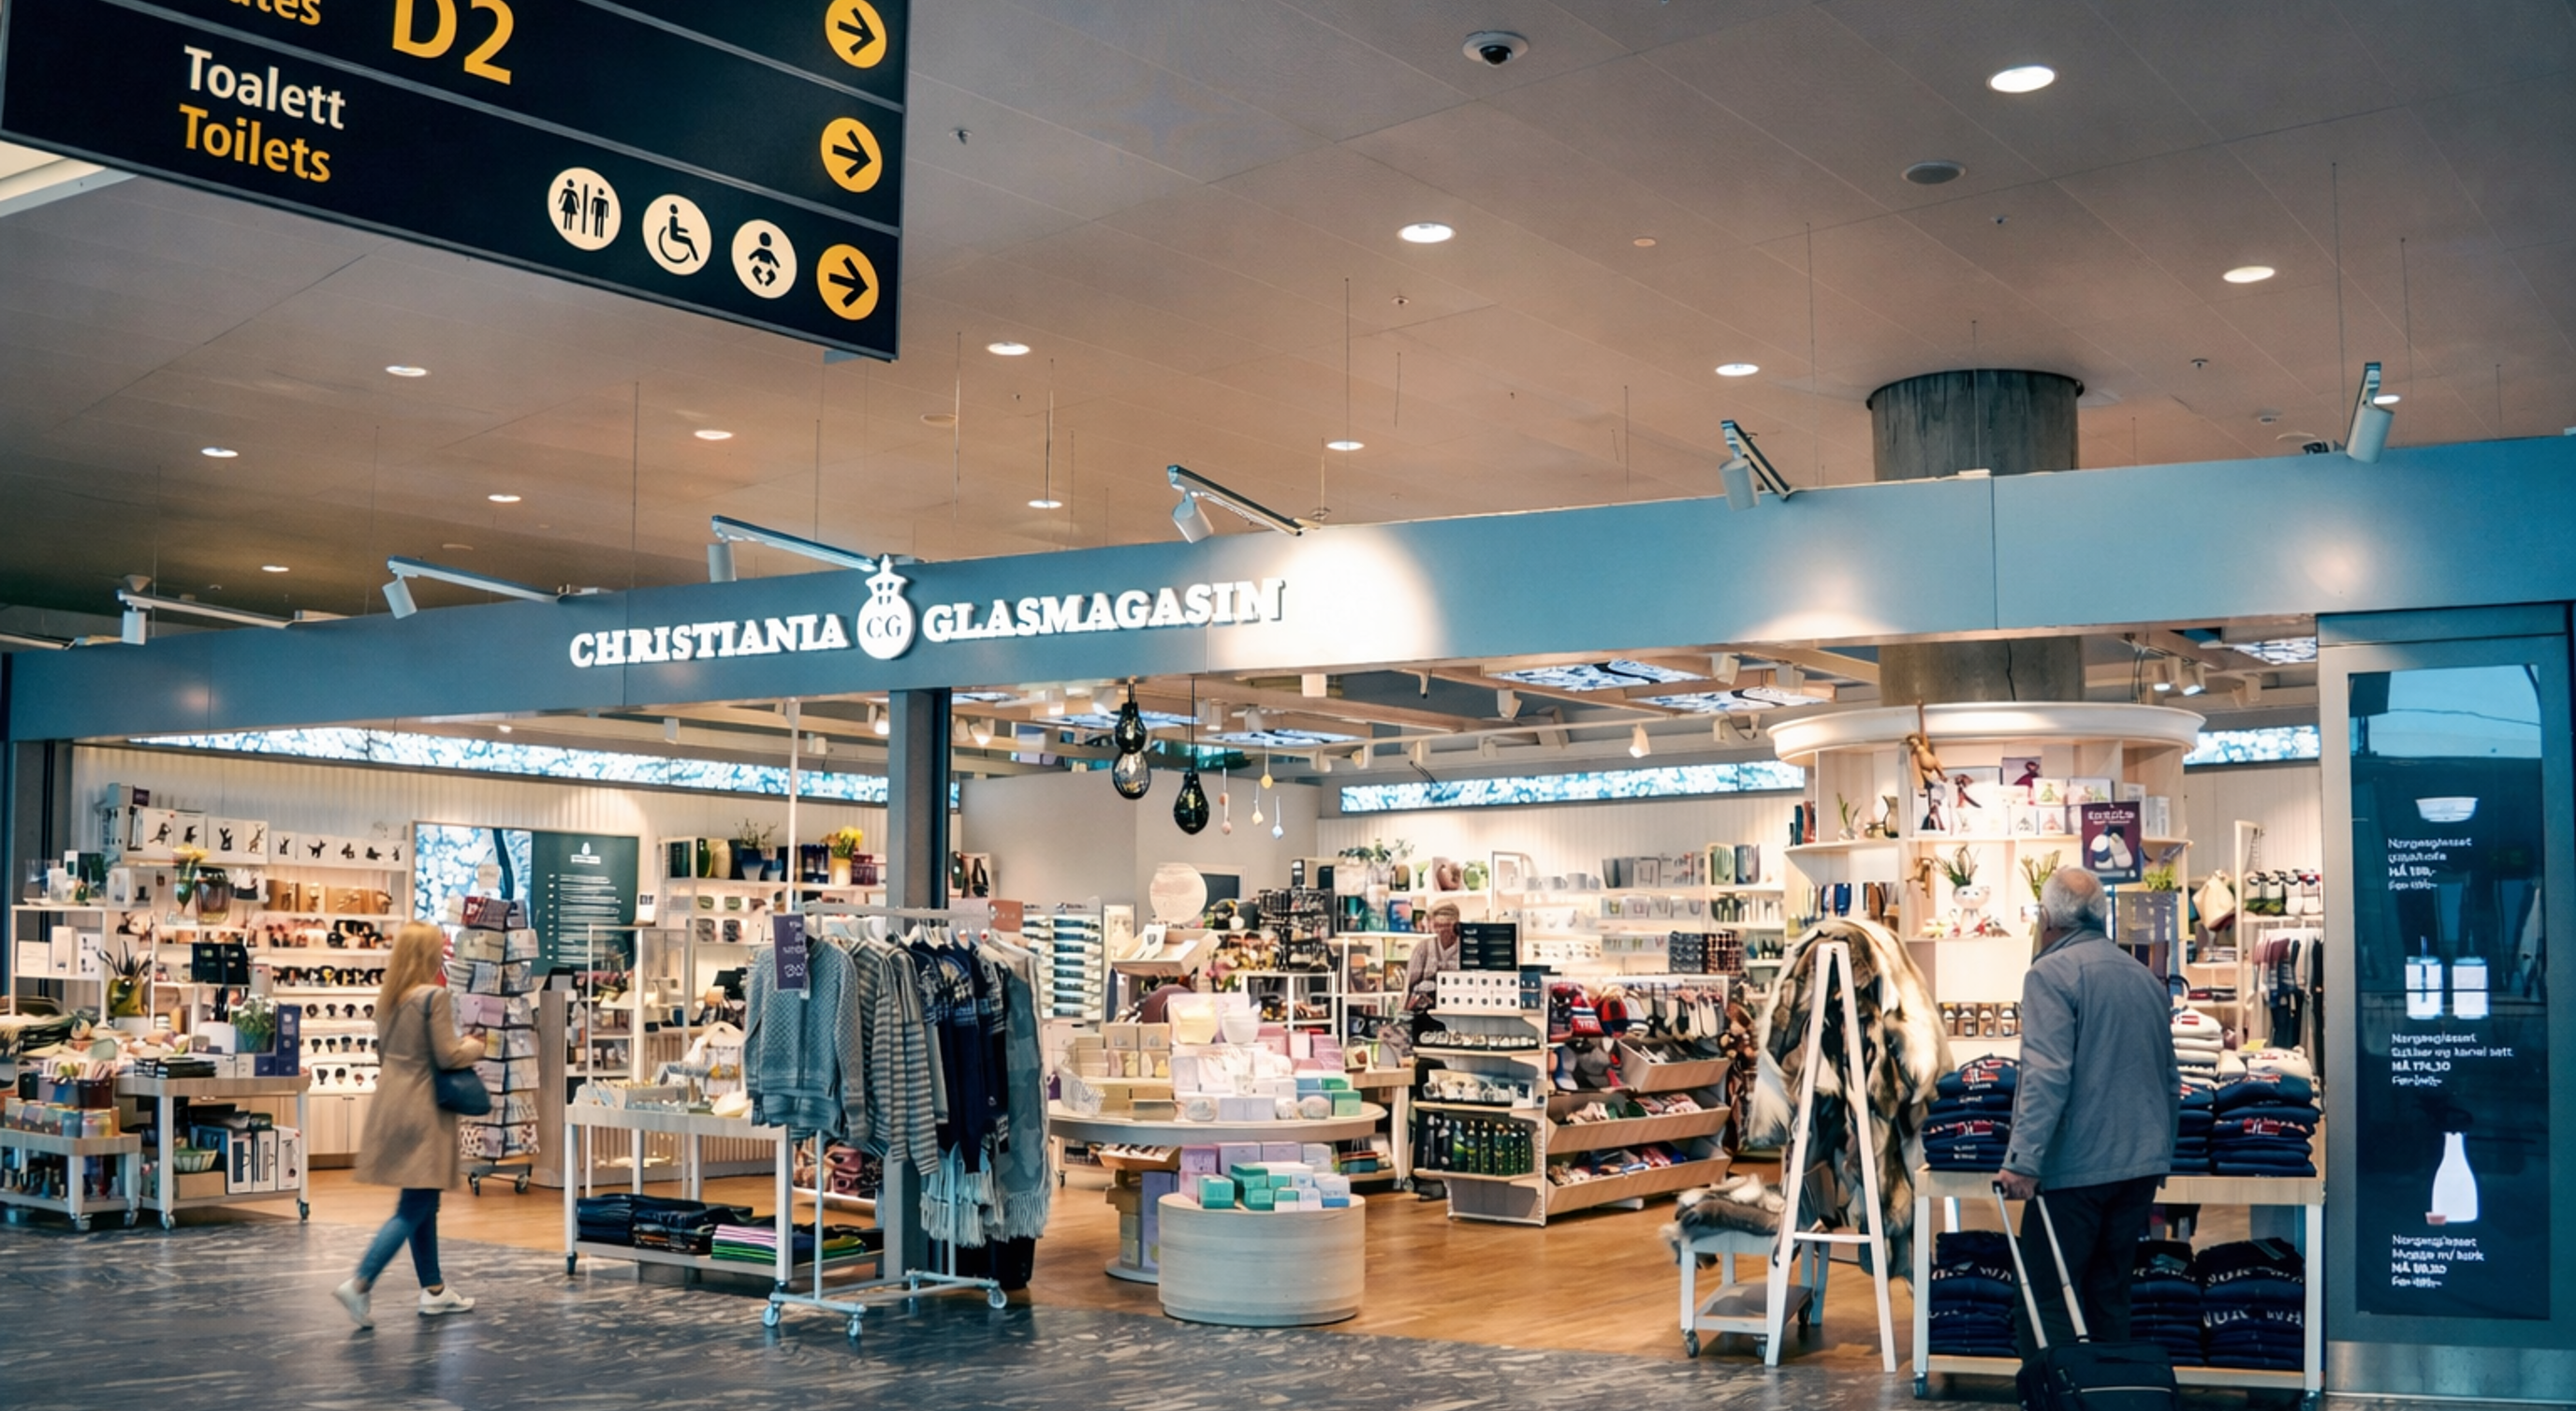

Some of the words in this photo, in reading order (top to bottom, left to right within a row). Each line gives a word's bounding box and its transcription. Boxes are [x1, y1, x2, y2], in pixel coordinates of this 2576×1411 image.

[392, 0, 515, 85] D2
[183, 44, 346, 130] Toalett
[179, 103, 331, 184] Toilets
[569, 611, 848, 669] CHRISTIANIA
[866, 614, 901, 639] CG
[922, 576, 1286, 643] GLASMAGASIN
